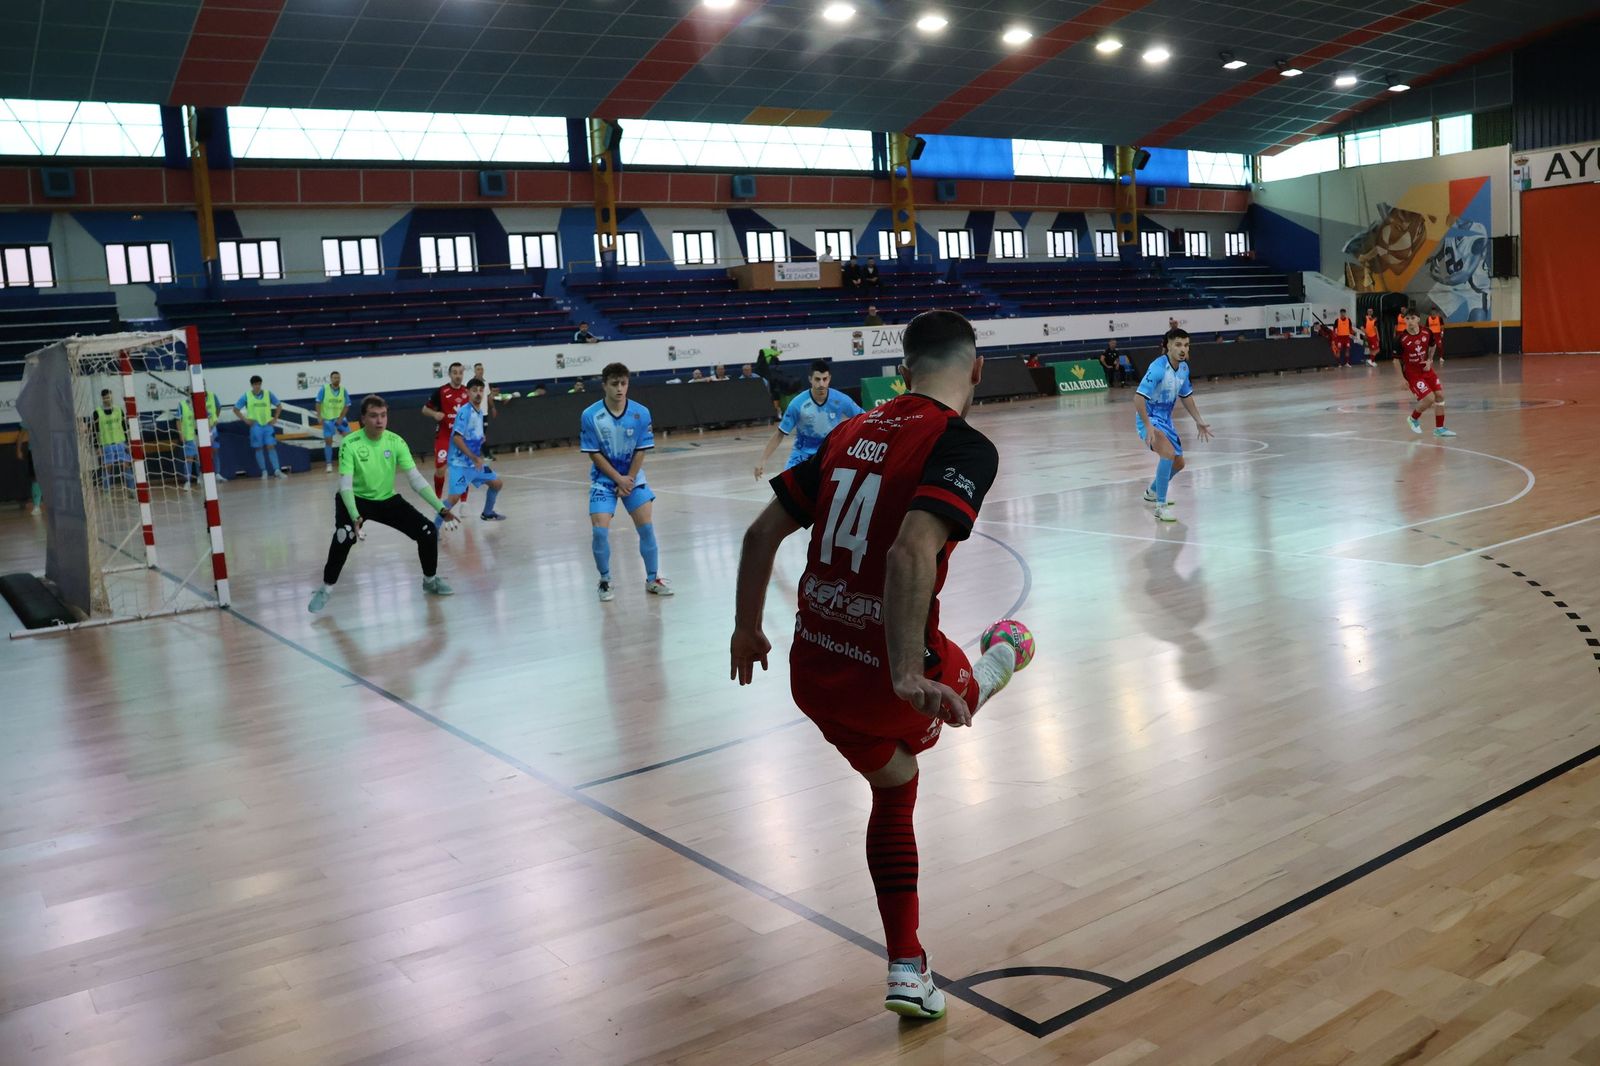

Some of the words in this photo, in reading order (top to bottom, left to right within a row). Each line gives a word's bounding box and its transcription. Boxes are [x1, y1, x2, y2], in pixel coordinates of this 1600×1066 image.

[1544, 147, 1600, 181] AY
[1059, 381, 1081, 392] CAJA
[1079, 378, 1107, 390] RURAL
[820, 467, 883, 575] 14
